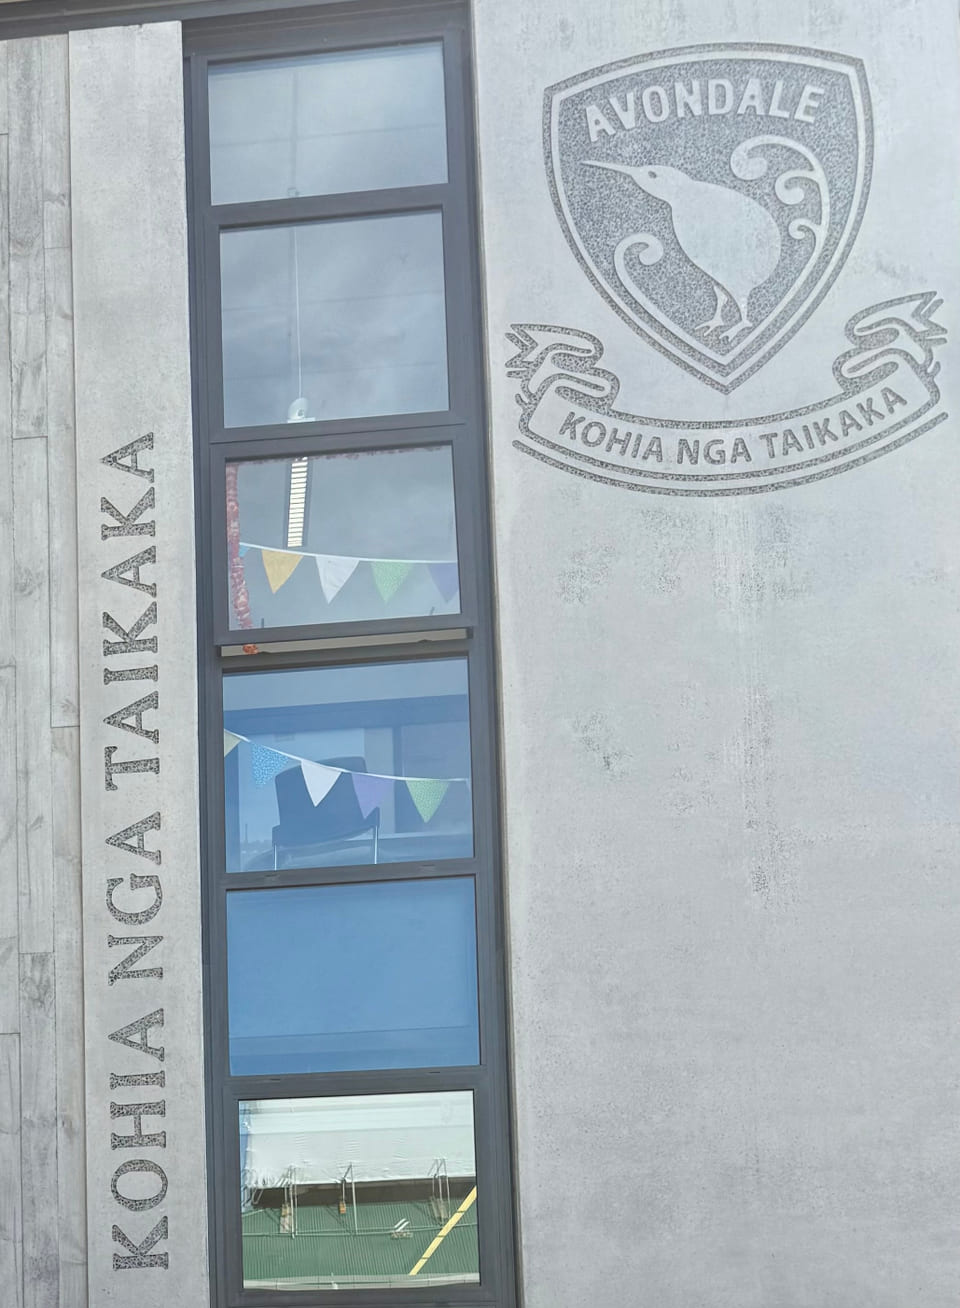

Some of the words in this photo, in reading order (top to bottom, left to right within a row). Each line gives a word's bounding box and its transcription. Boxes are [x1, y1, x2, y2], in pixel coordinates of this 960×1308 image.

[583, 78, 825, 143] AVONDALE
[558, 411, 664, 463] KOHIA
[676, 437, 752, 465] NGA
[758, 386, 908, 459] TAIKAKA
[99, 431, 160, 791] TAIKAKA
[105, 811, 164, 986] NGA
[107, 1008, 169, 1271] KOHIA
